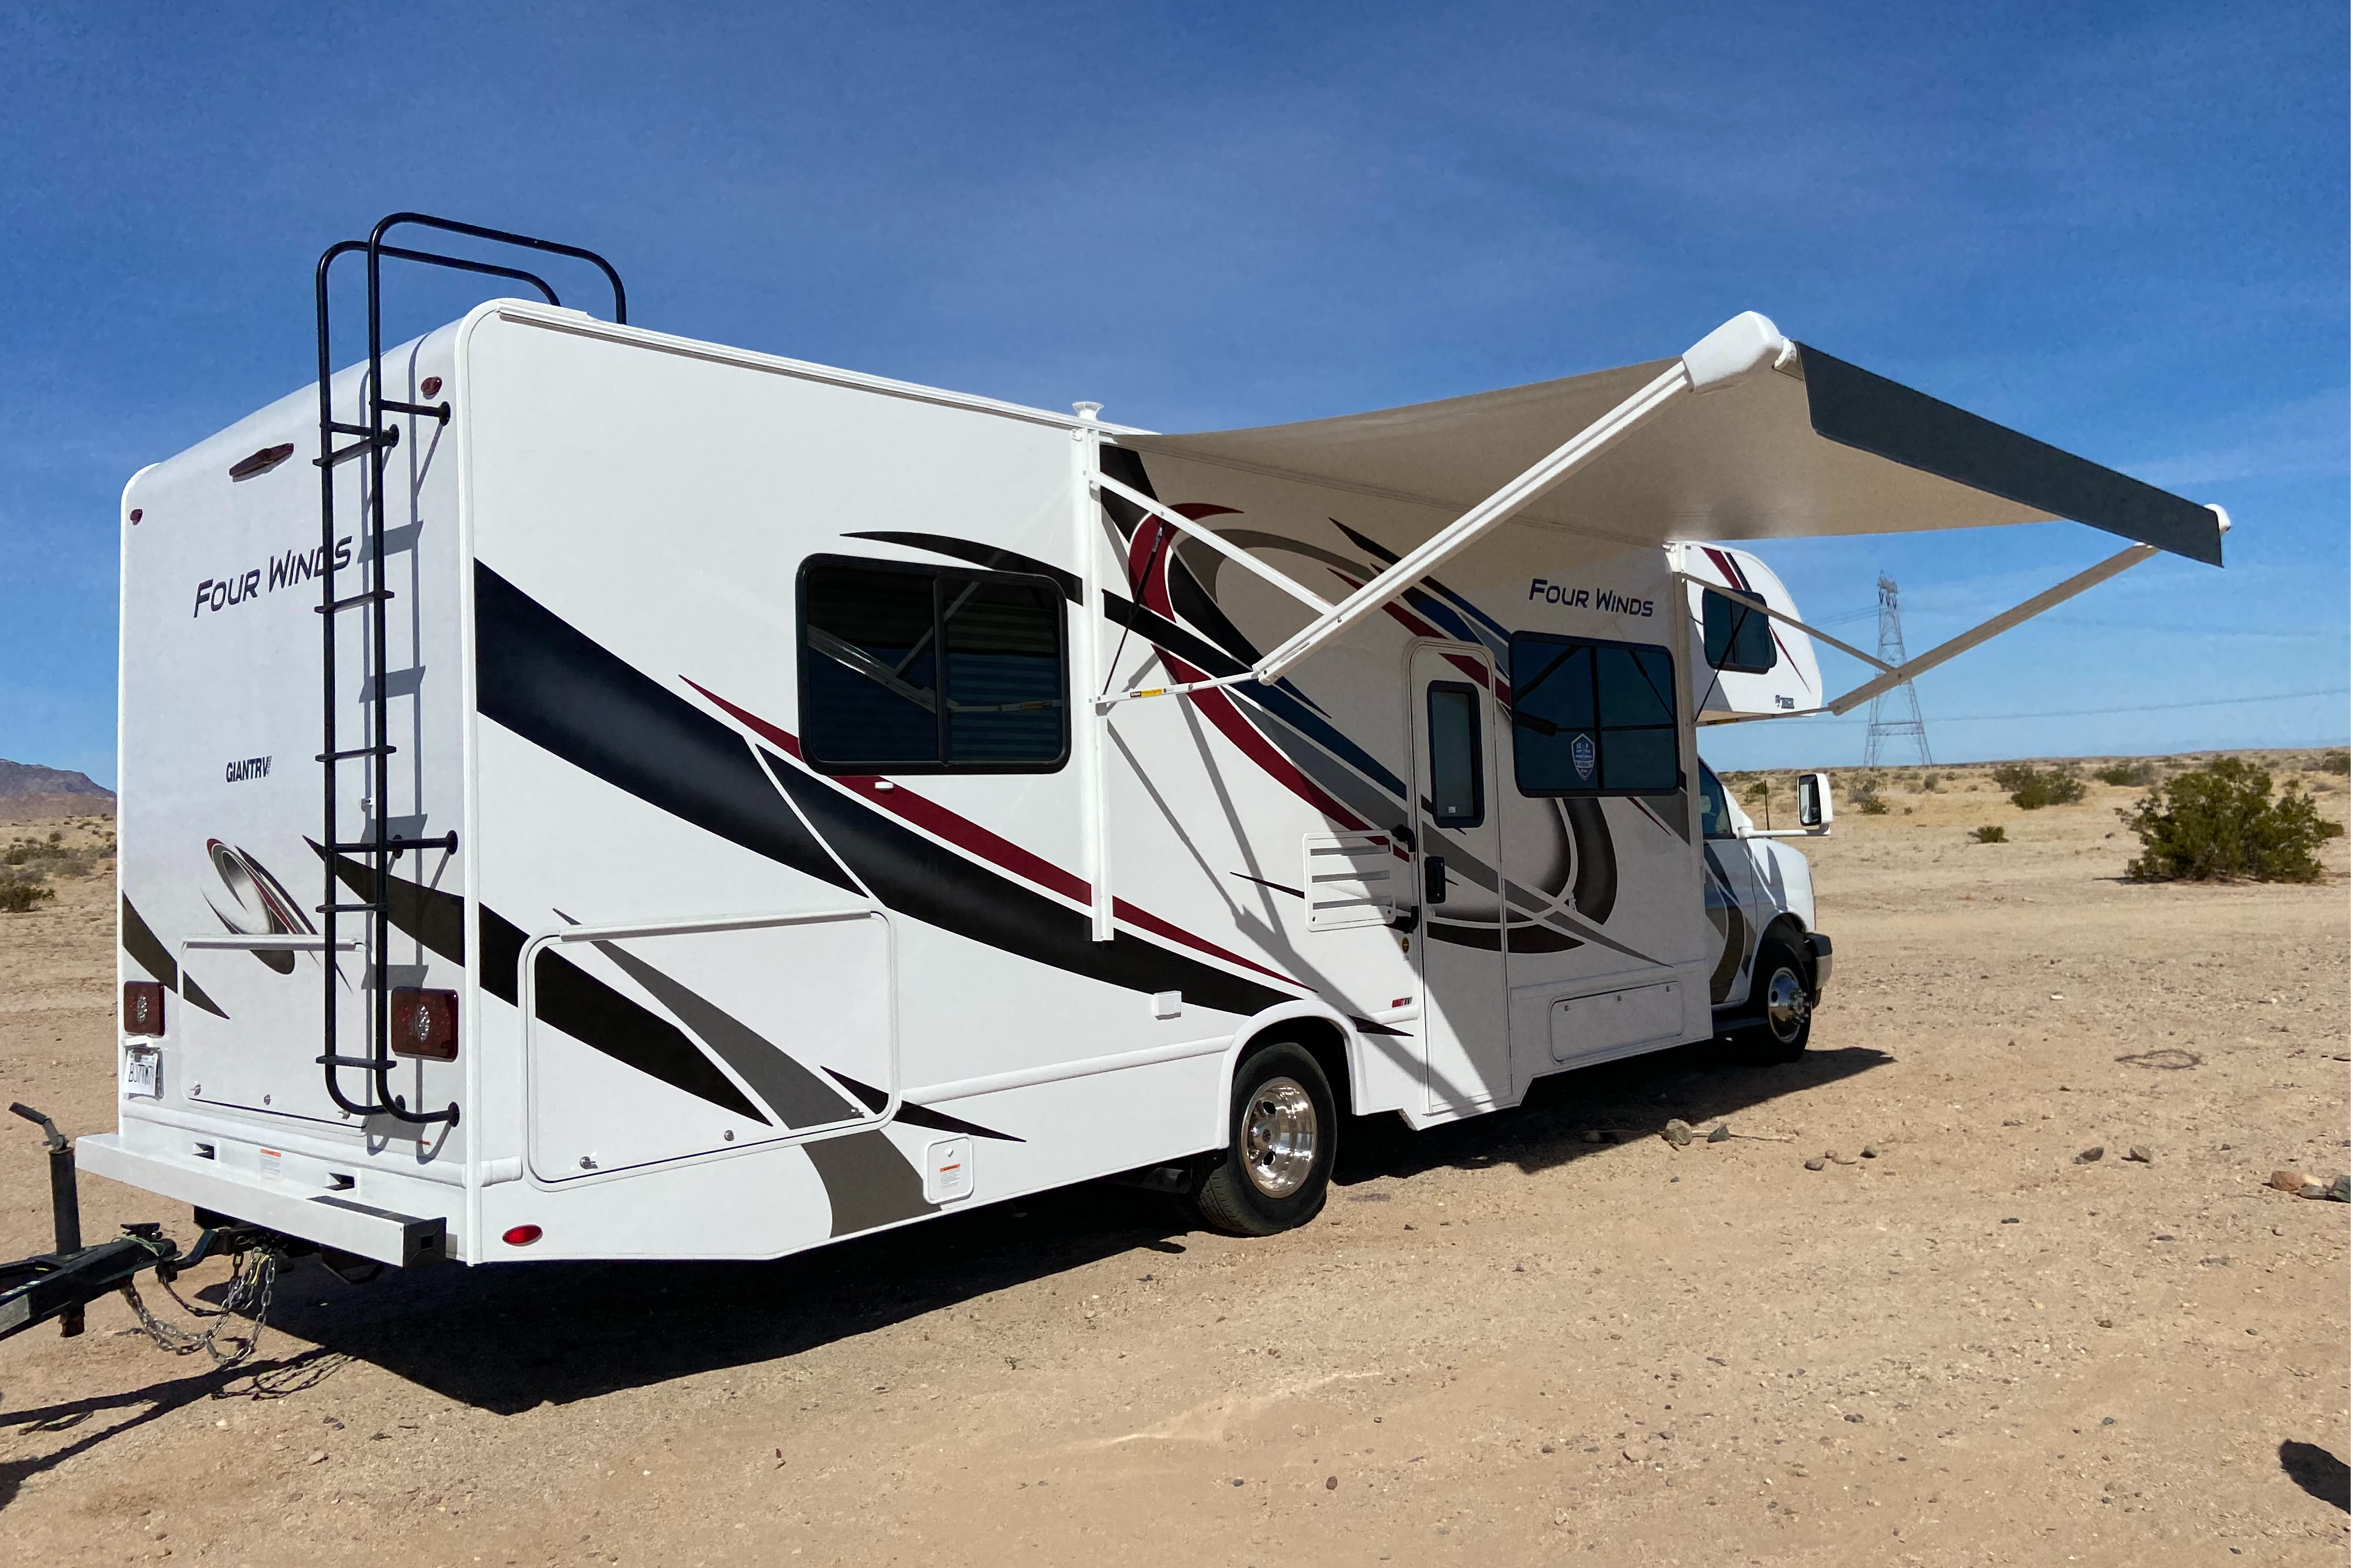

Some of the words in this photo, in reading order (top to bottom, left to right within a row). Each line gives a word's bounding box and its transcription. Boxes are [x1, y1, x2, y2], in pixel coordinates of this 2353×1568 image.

[193, 569, 261, 618] FOUR
[1529, 578, 1589, 608] FOUR
[1596, 588, 1654, 618] WINDS
